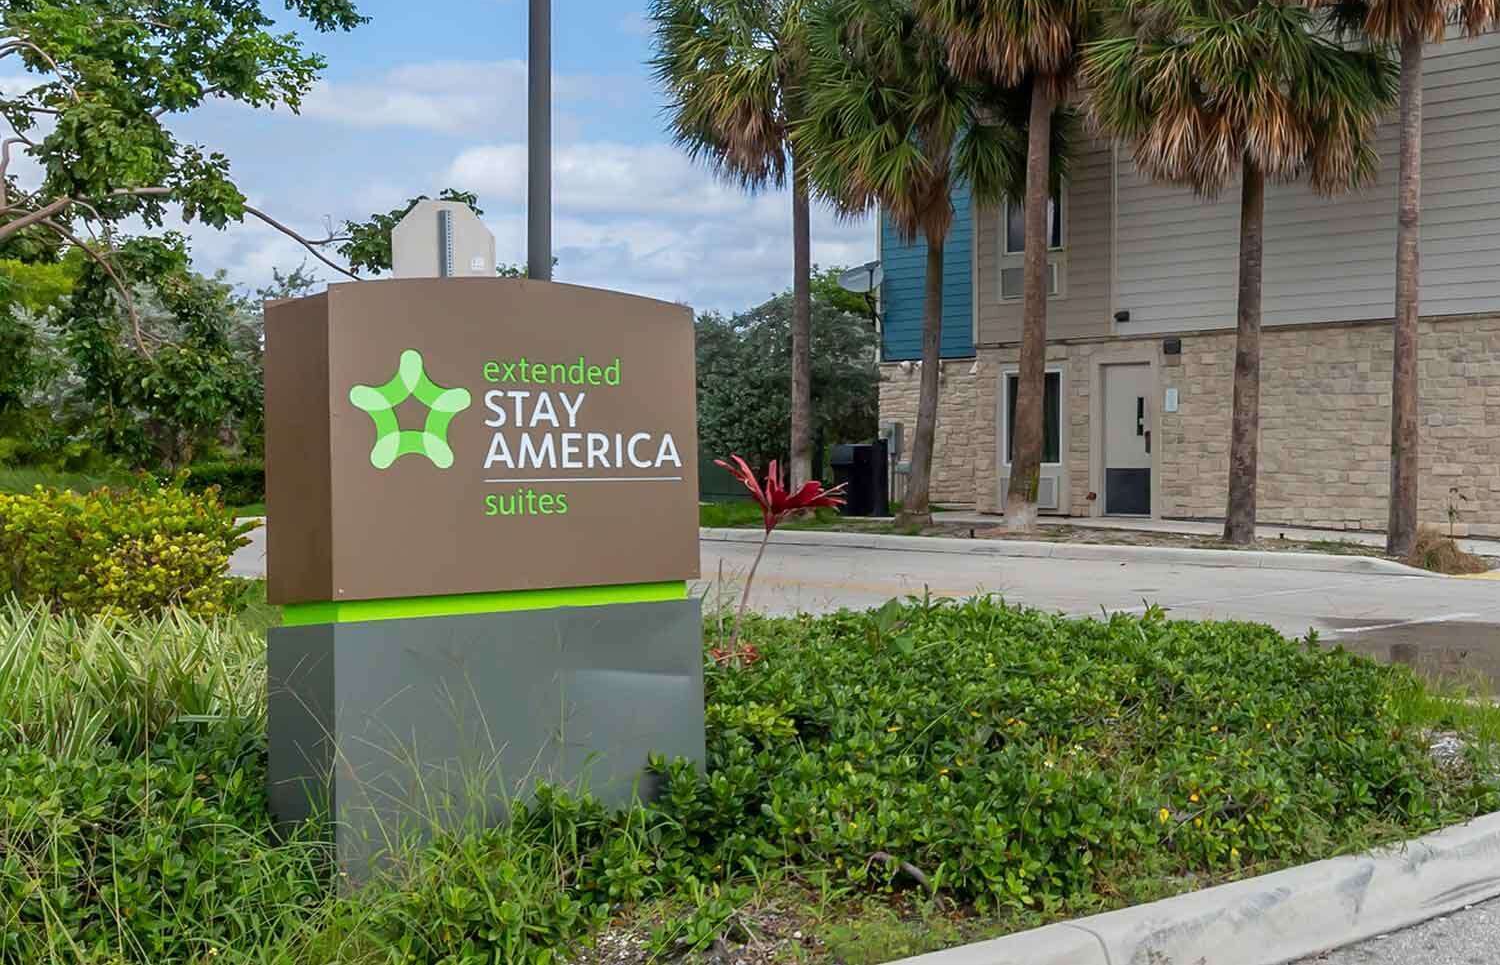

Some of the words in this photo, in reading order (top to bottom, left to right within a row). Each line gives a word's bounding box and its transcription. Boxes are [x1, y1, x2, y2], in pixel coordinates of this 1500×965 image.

[483, 356, 621, 385] extended
[483, 390, 586, 427] STAY
[483, 432, 682, 469] AMERICA
[484, 489, 569, 516] suites
